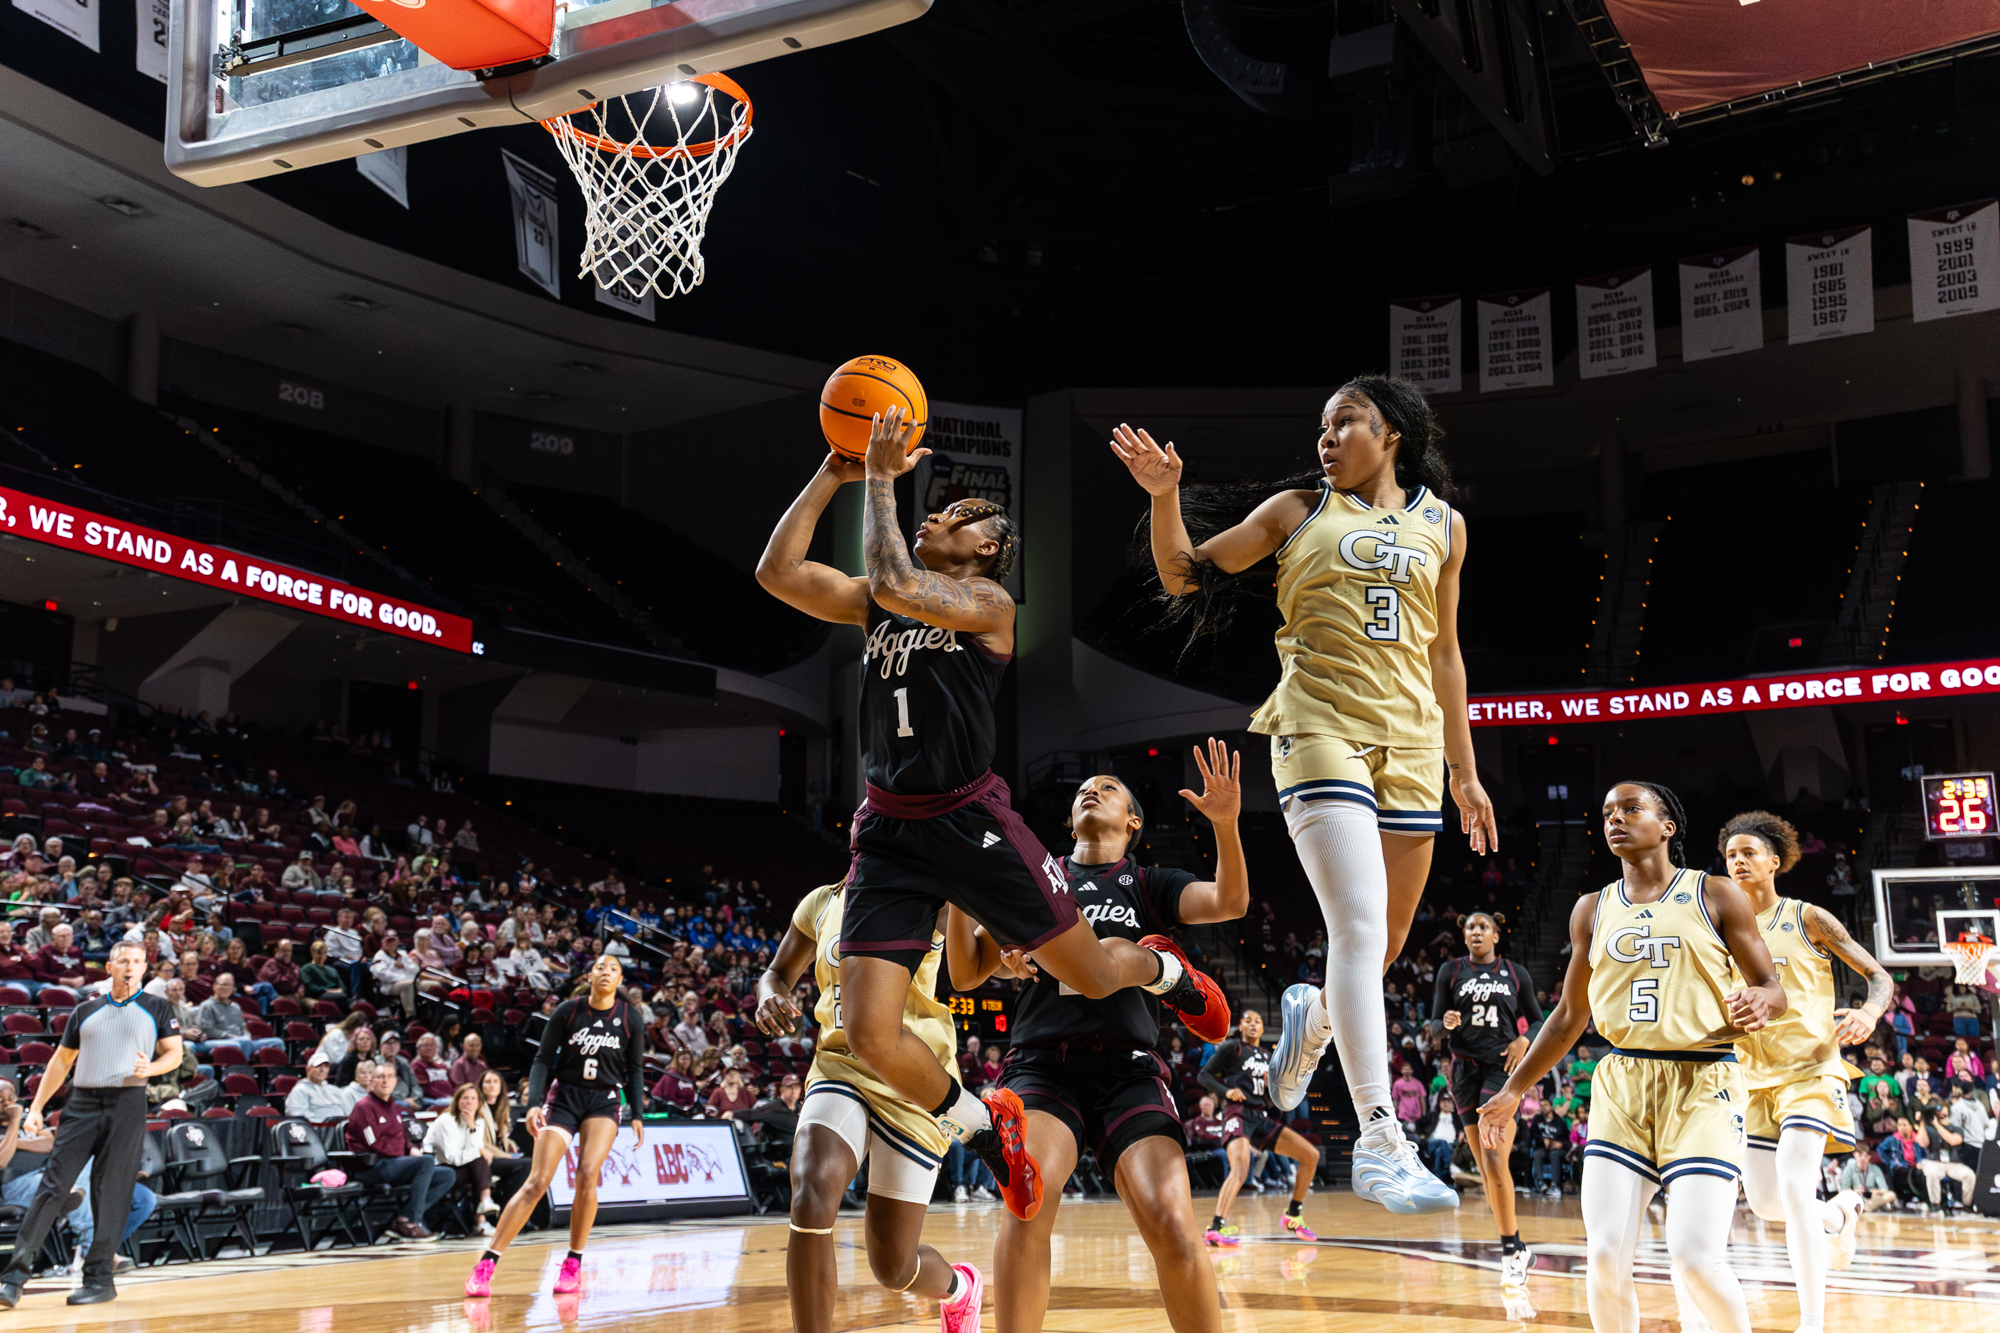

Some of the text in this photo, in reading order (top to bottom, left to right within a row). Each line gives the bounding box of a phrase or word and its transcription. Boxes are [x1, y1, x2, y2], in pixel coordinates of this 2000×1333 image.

[1935, 237, 1974, 256] 1999
[1813, 262, 1844, 280] 1981
[1938, 253, 1975, 272] 2001
[1937, 269, 1977, 288] 2003
[1812, 293, 1847, 311] 1995
[1937, 285, 1979, 304] 2009
[1813, 310, 1847, 326] 1997
[278, 379, 325, 410] 208
[932, 416, 1002, 439] NATIONAL
[530, 430, 574, 455] 209
[922, 432, 1011, 457] CHAMPIONS
[950, 464, 1007, 490] FINAL
[1339, 529, 1427, 584] GT
[29, 505, 74, 539] WE
[84, 521, 172, 564] STAND
[180, 549, 214, 576] AS
[220, 559, 239, 584] A
[246, 565, 323, 606] FORCE
[329, 588, 373, 619] FOR
[378, 603, 442, 638] GOOD.
[1364, 586, 1400, 641] 3
[863, 619, 964, 680] Aggies
[1561, 698, 1600, 717] WE
[1609, 691, 1690, 715] STAND
[1700, 687, 1733, 708] AS
[1742, 685, 1761, 704] A
[1769, 676, 1862, 702] FORCE
[1872, 671, 1931, 694] FOR
[894, 687, 914, 737] 1
[1942, 778, 1988, 800] 2:33
[1939, 797, 1986, 832] 26
[1606, 925, 1681, 968] GT
[1459, 977, 1512, 1003] Aggies
[1629, 979, 1658, 1022] 5
[948, 996, 975, 1015] 2:33
[1471, 1004, 1499, 1028] 24
[568, 1027, 621, 1056] Aggies
[583, 1058, 599, 1081] 6
[654, 1144, 689, 1186] ABC
